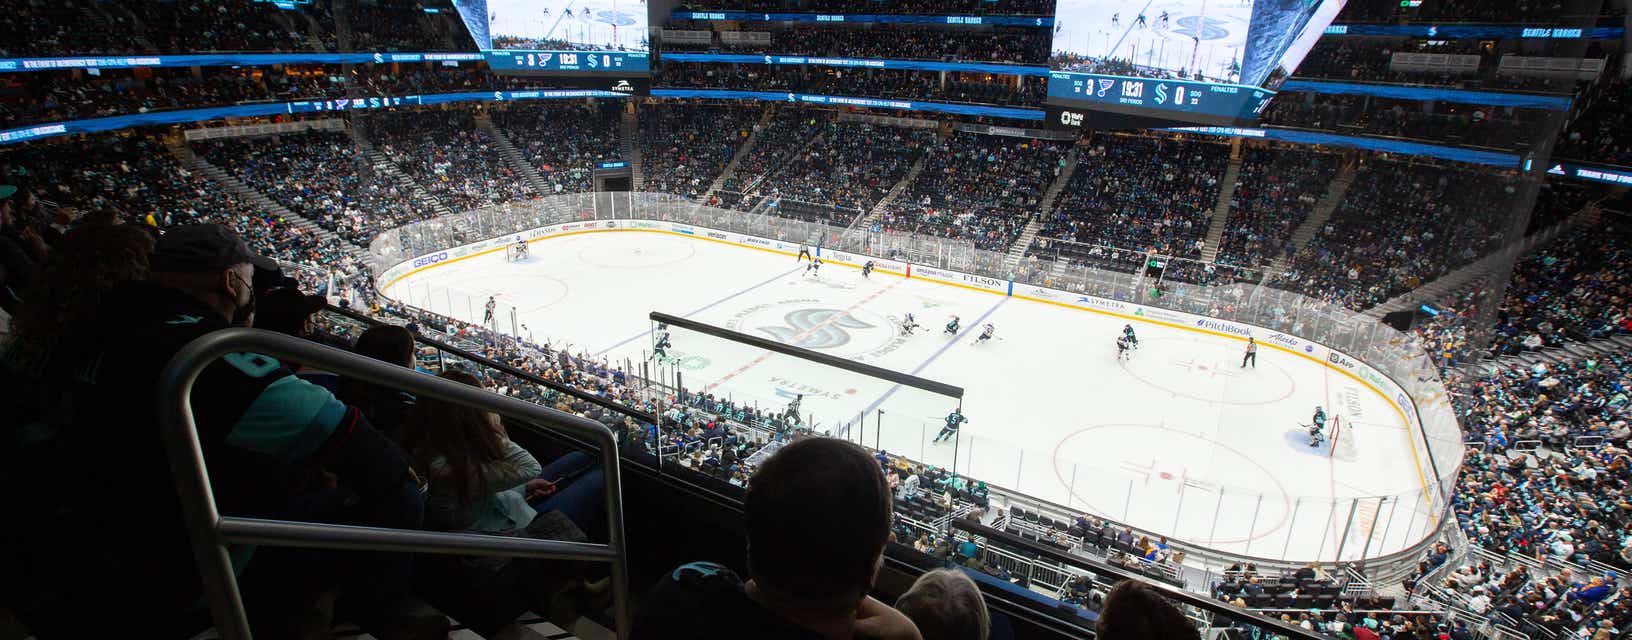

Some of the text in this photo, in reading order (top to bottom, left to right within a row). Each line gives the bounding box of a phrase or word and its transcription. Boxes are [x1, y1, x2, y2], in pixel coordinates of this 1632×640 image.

[603, 54, 610, 67] 0
[1086, 79, 1094, 96] 3
[1121, 80, 1144, 97] 19:31
[1174, 86, 1185, 105] 0
[414, 252, 448, 268] GEICO
[963, 274, 1001, 287] FILSON
[1090, 298, 1125, 310] SYMETRA
[1205, 320, 1251, 336] PitchBook
[1268, 333, 1298, 346] Alaska
[950, 416, 957, 424] 5
